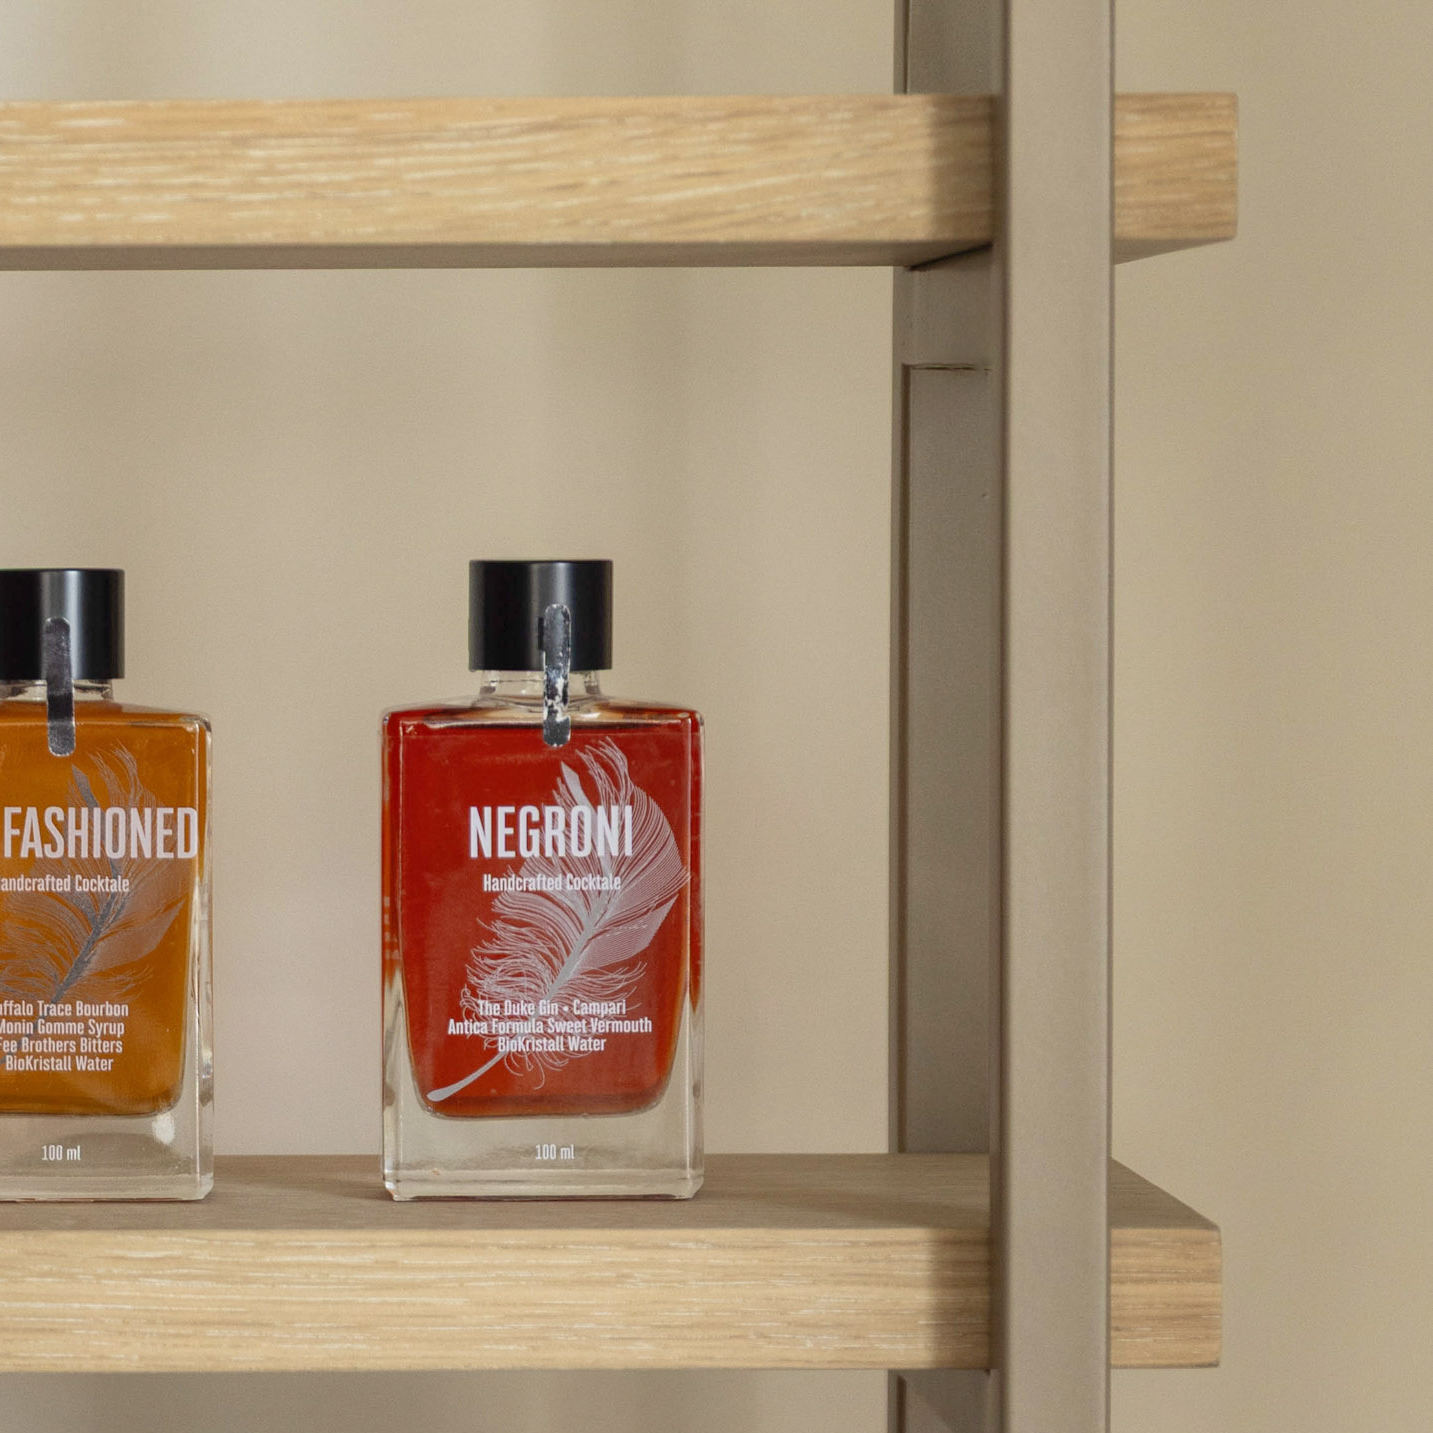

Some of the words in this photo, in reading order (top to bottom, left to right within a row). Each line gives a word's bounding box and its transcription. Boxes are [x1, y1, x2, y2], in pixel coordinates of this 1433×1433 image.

[3, 806, 199, 859] FASHIONED
[469, 805, 633, 858] NEGRONI
[75, 874, 130, 892] Cocktale
[483, 873, 562, 892] Handcrafted
[565, 873, 621, 892] Cocktale
[37, 1000, 72, 1016] Trace
[76, 1001, 129, 1017] Bourbon
[478, 1000, 501, 1015] The
[504, 1000, 535, 1015] Duke
[539, 1000, 559, 1015] Gin
[573, 999, 626, 1018] Campari
[37, 1019, 84, 1035] Gomme
[88, 1019, 125, 1038] Syrup
[448, 1019, 488, 1034] Antica
[492, 1018, 544, 1034] Formula
[547, 1018, 586, 1034] Sweet
[590, 1017, 652, 1033] Vermouth
[21, 1037, 76, 1053] Brothers
[80, 1037, 123, 1053] Bitters
[498, 1036, 564, 1052] BioKristall
[568, 1036, 606, 1051] Water
[5, 1055, 72, 1071] BioKristall
[75, 1055, 114, 1071] Water
[41, 1145, 63, 1161] 100
[66, 1145, 81, 1161] ml
[535, 1144, 556, 1160] 100
[560, 1144, 575, 1160] ml
